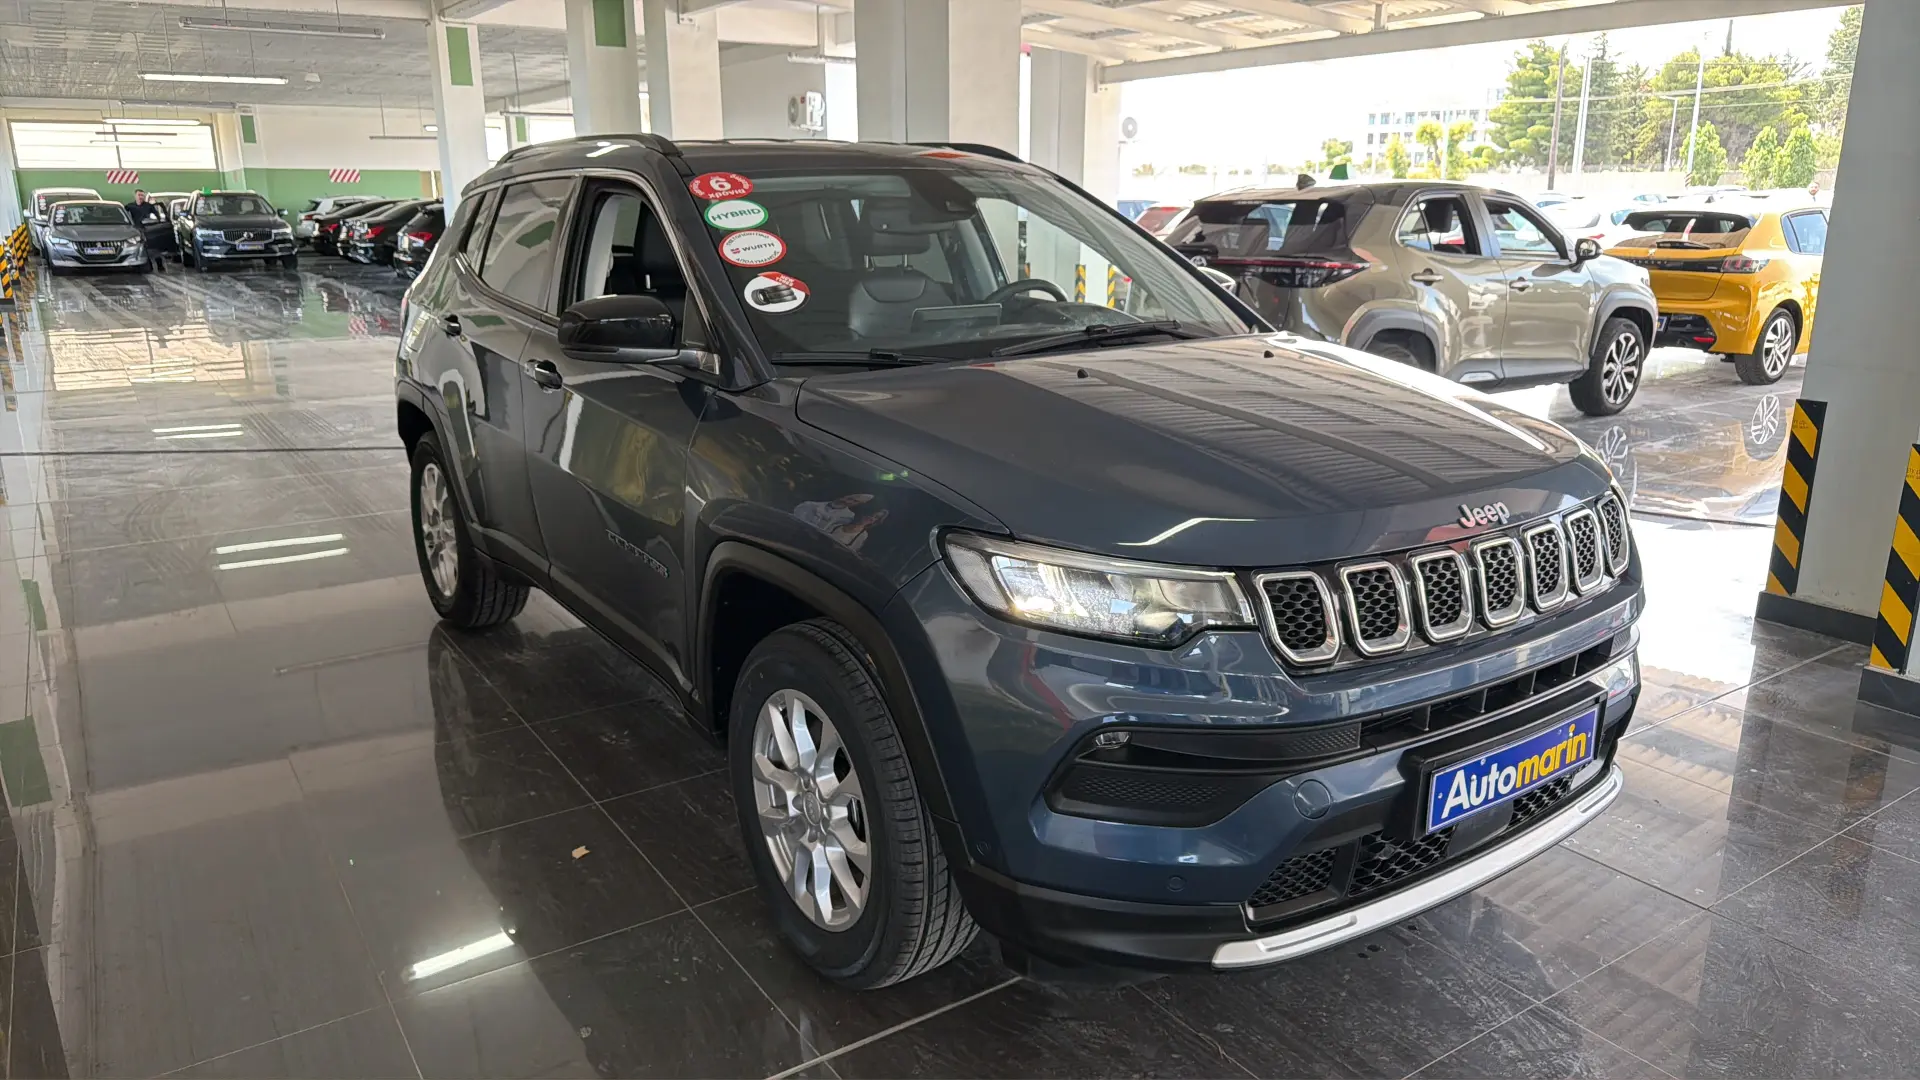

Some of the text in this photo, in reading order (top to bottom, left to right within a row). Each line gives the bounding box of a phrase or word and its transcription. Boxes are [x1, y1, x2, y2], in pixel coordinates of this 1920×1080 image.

[709, 176, 731, 191] 6
[711, 208, 761, 221] HYBRID
[1459, 501, 1510, 527] Jeep
[1441, 723, 1587, 820] Automarin
